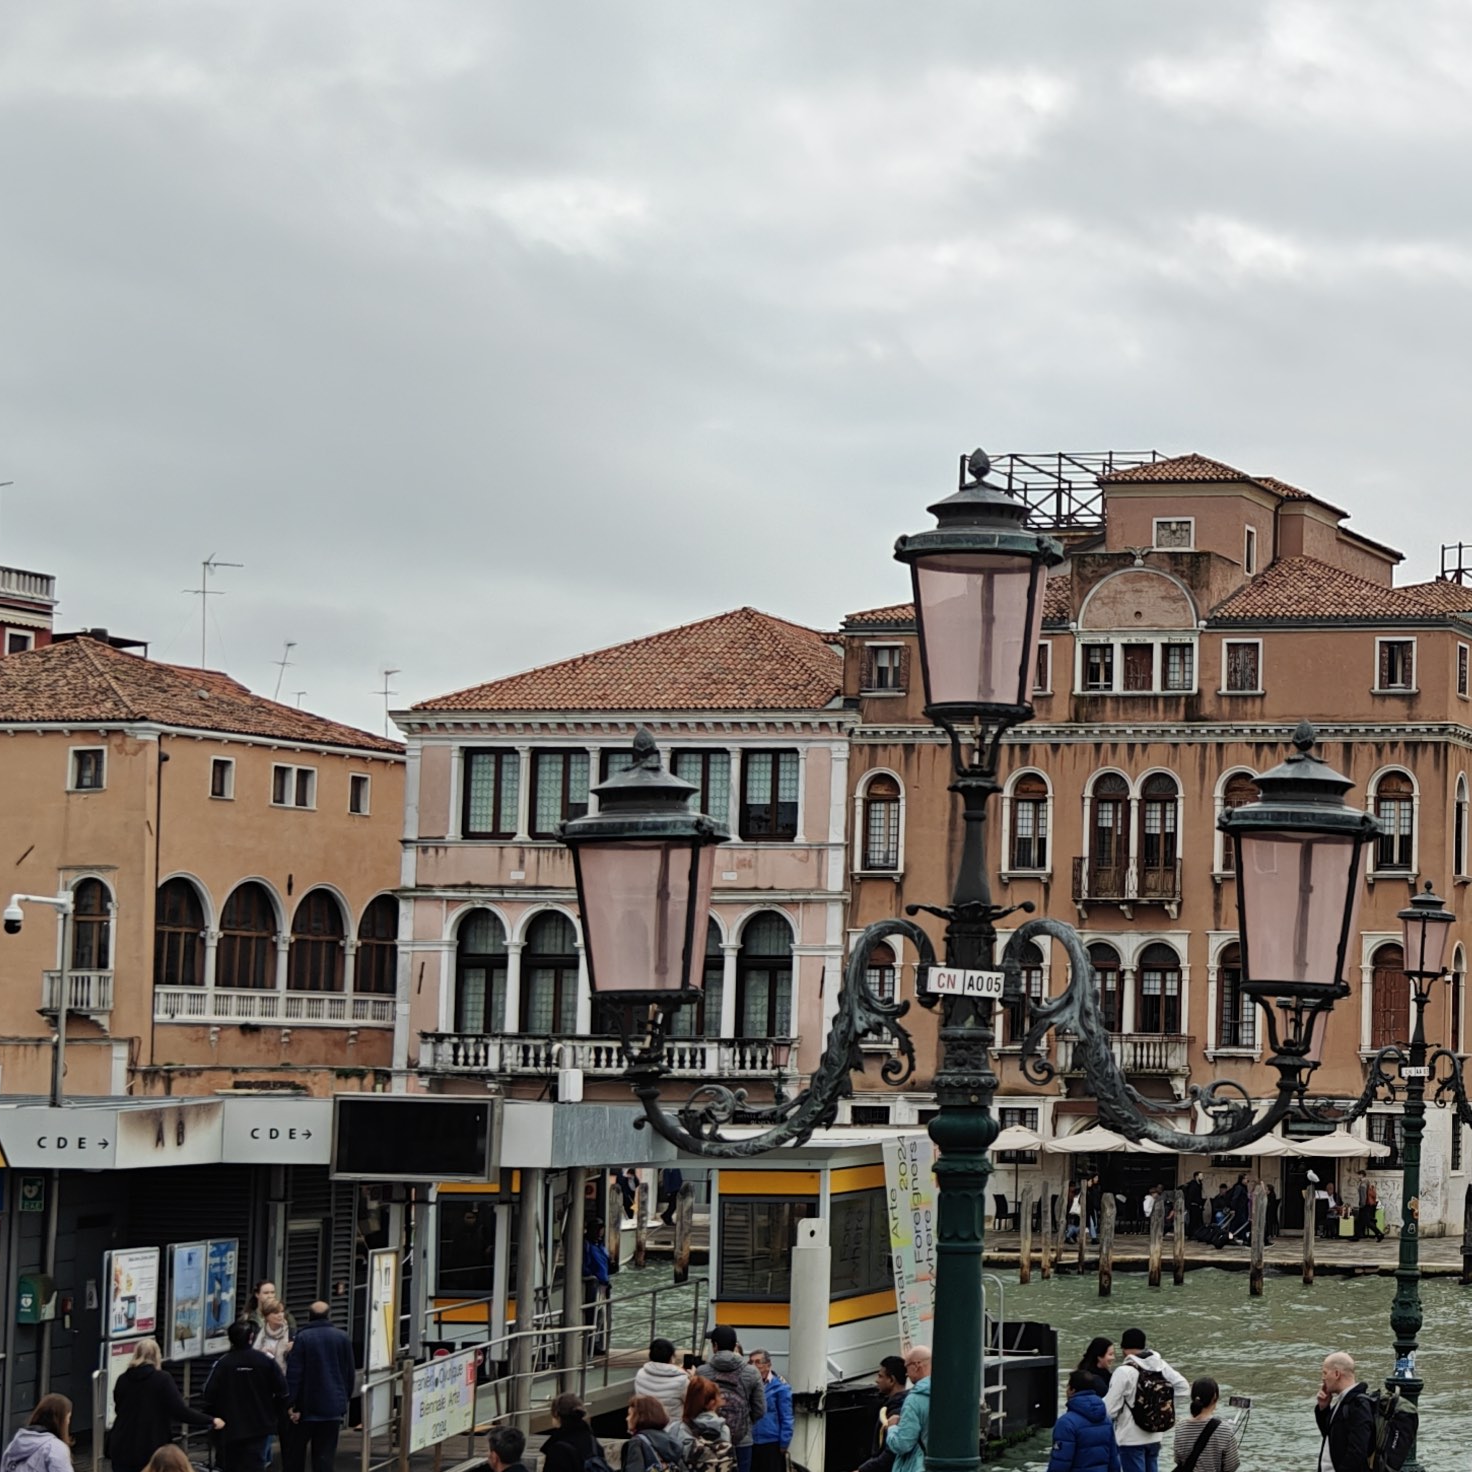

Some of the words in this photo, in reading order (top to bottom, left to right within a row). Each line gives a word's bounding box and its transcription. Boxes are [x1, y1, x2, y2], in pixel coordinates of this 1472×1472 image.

[937, 972, 956, 990] CN
[37, 1137, 47, 1149] C
[57, 1137, 67, 1149] D
[78, 1137, 86, 1149] E
[155, 1121, 165, 1148] A
[176, 1120, 185, 1146] B
[251, 1128, 260, 1139] C
[269, 1128, 279, 1139] D
[289, 1128, 296, 1139] E
[898, 1135, 909, 1191] 2024
[890, 1188, 900, 1239] Arte
[910, 1141, 924, 1264] Foreigners
